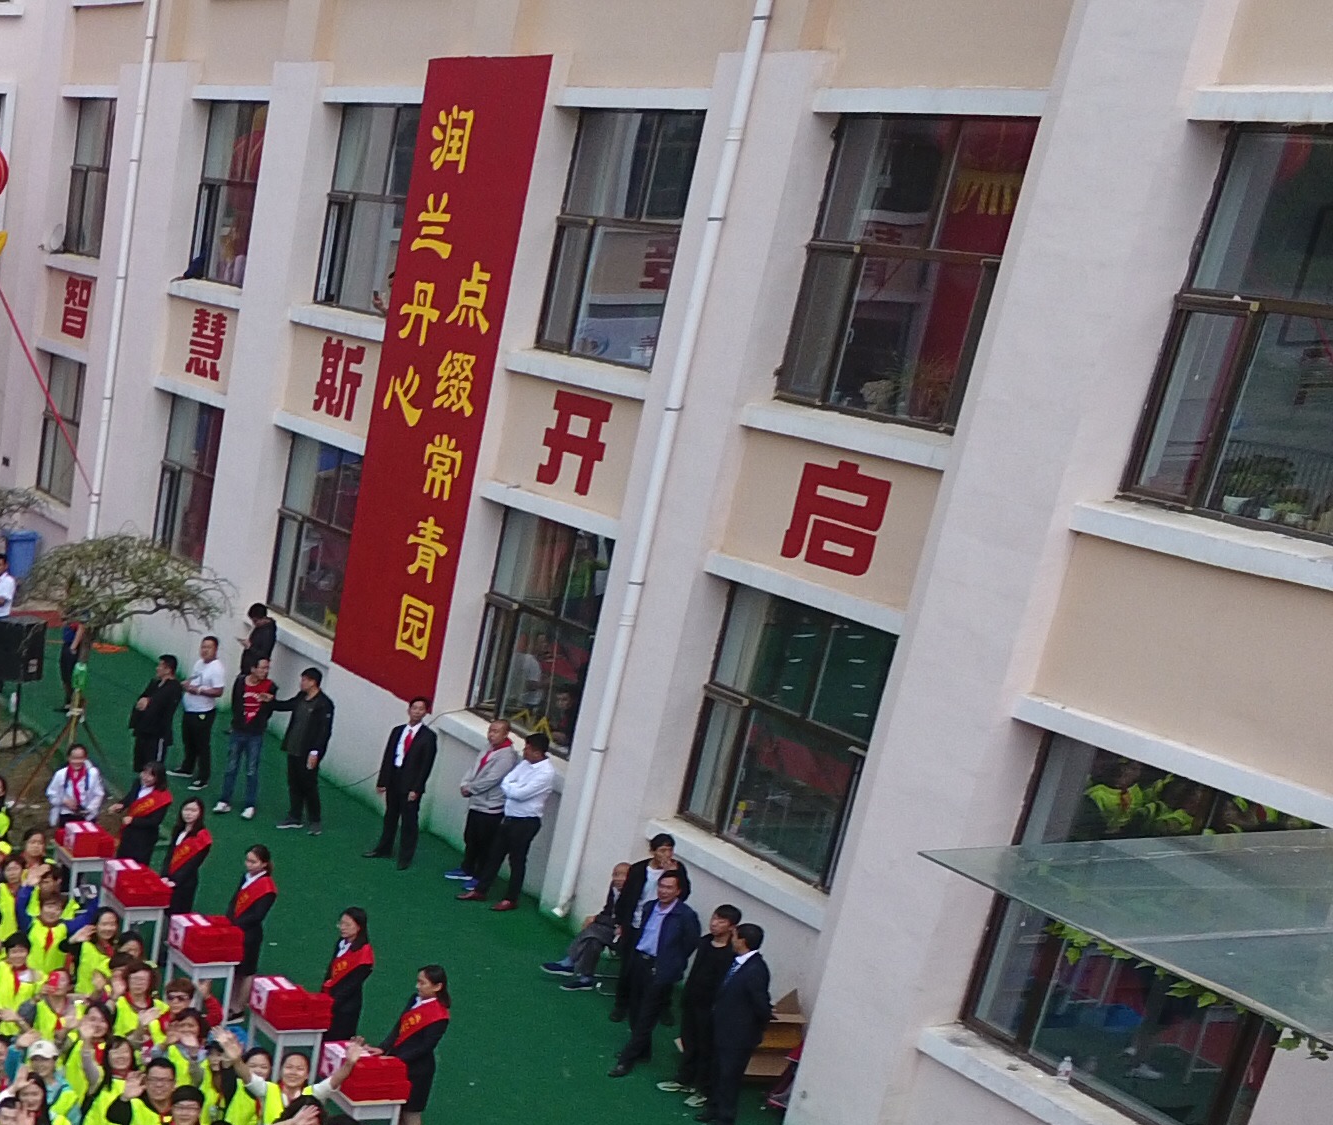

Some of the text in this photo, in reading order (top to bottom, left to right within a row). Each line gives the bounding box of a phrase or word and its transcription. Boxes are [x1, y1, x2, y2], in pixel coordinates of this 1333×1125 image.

[61, 276, 892, 577] 智 慧 斯 开 启
[383, 104, 474, 429] 润兰丹心
[394, 262, 491, 662] 点缀常青园
